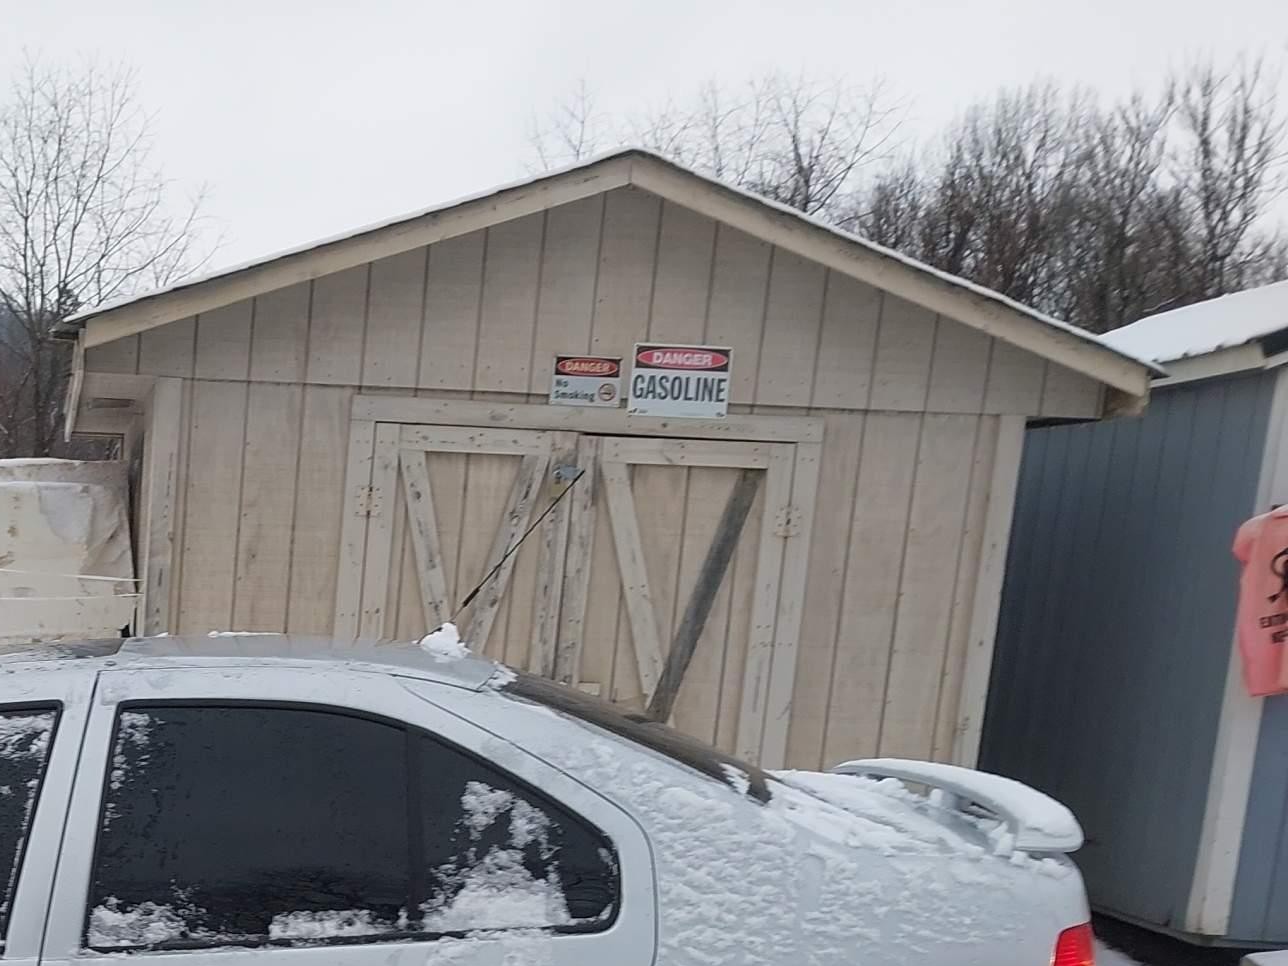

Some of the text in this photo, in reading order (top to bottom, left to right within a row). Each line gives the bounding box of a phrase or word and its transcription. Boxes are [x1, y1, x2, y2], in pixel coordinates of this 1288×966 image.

[652, 351, 712, 366] DANGER
[566, 361, 610, 373] DANGER
[632, 374, 727, 402] GASOLINE
[554, 390, 595, 402] Smoking
